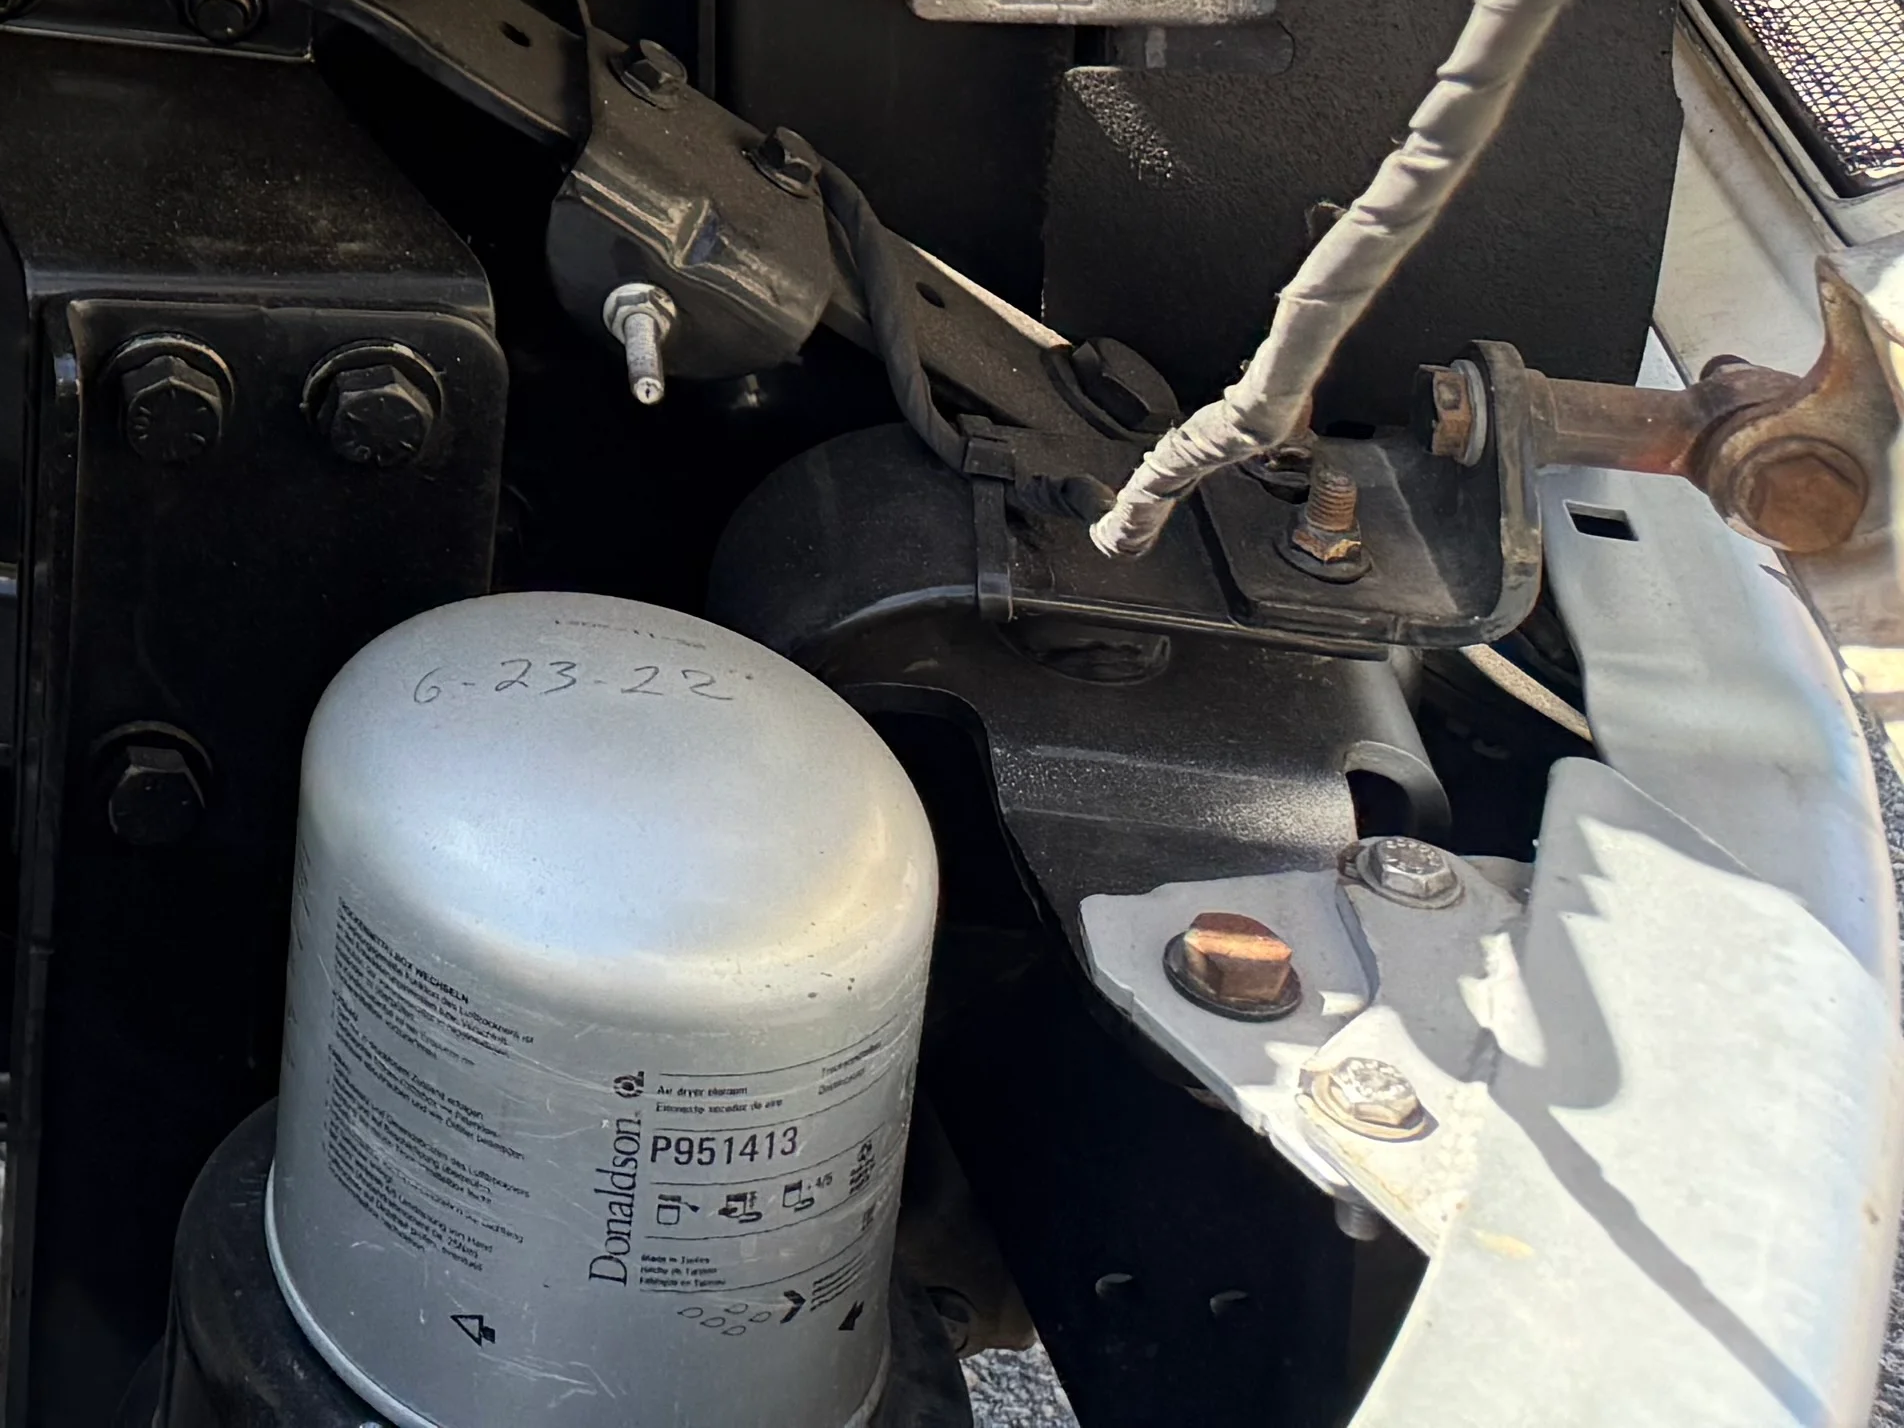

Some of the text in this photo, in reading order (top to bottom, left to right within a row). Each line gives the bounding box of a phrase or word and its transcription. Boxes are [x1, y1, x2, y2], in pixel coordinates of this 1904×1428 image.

[416, 968, 469, 1004] WECHSELN
[650, 1126, 799, 1166] P951413
[588, 1117, 642, 1286] Donaldson
